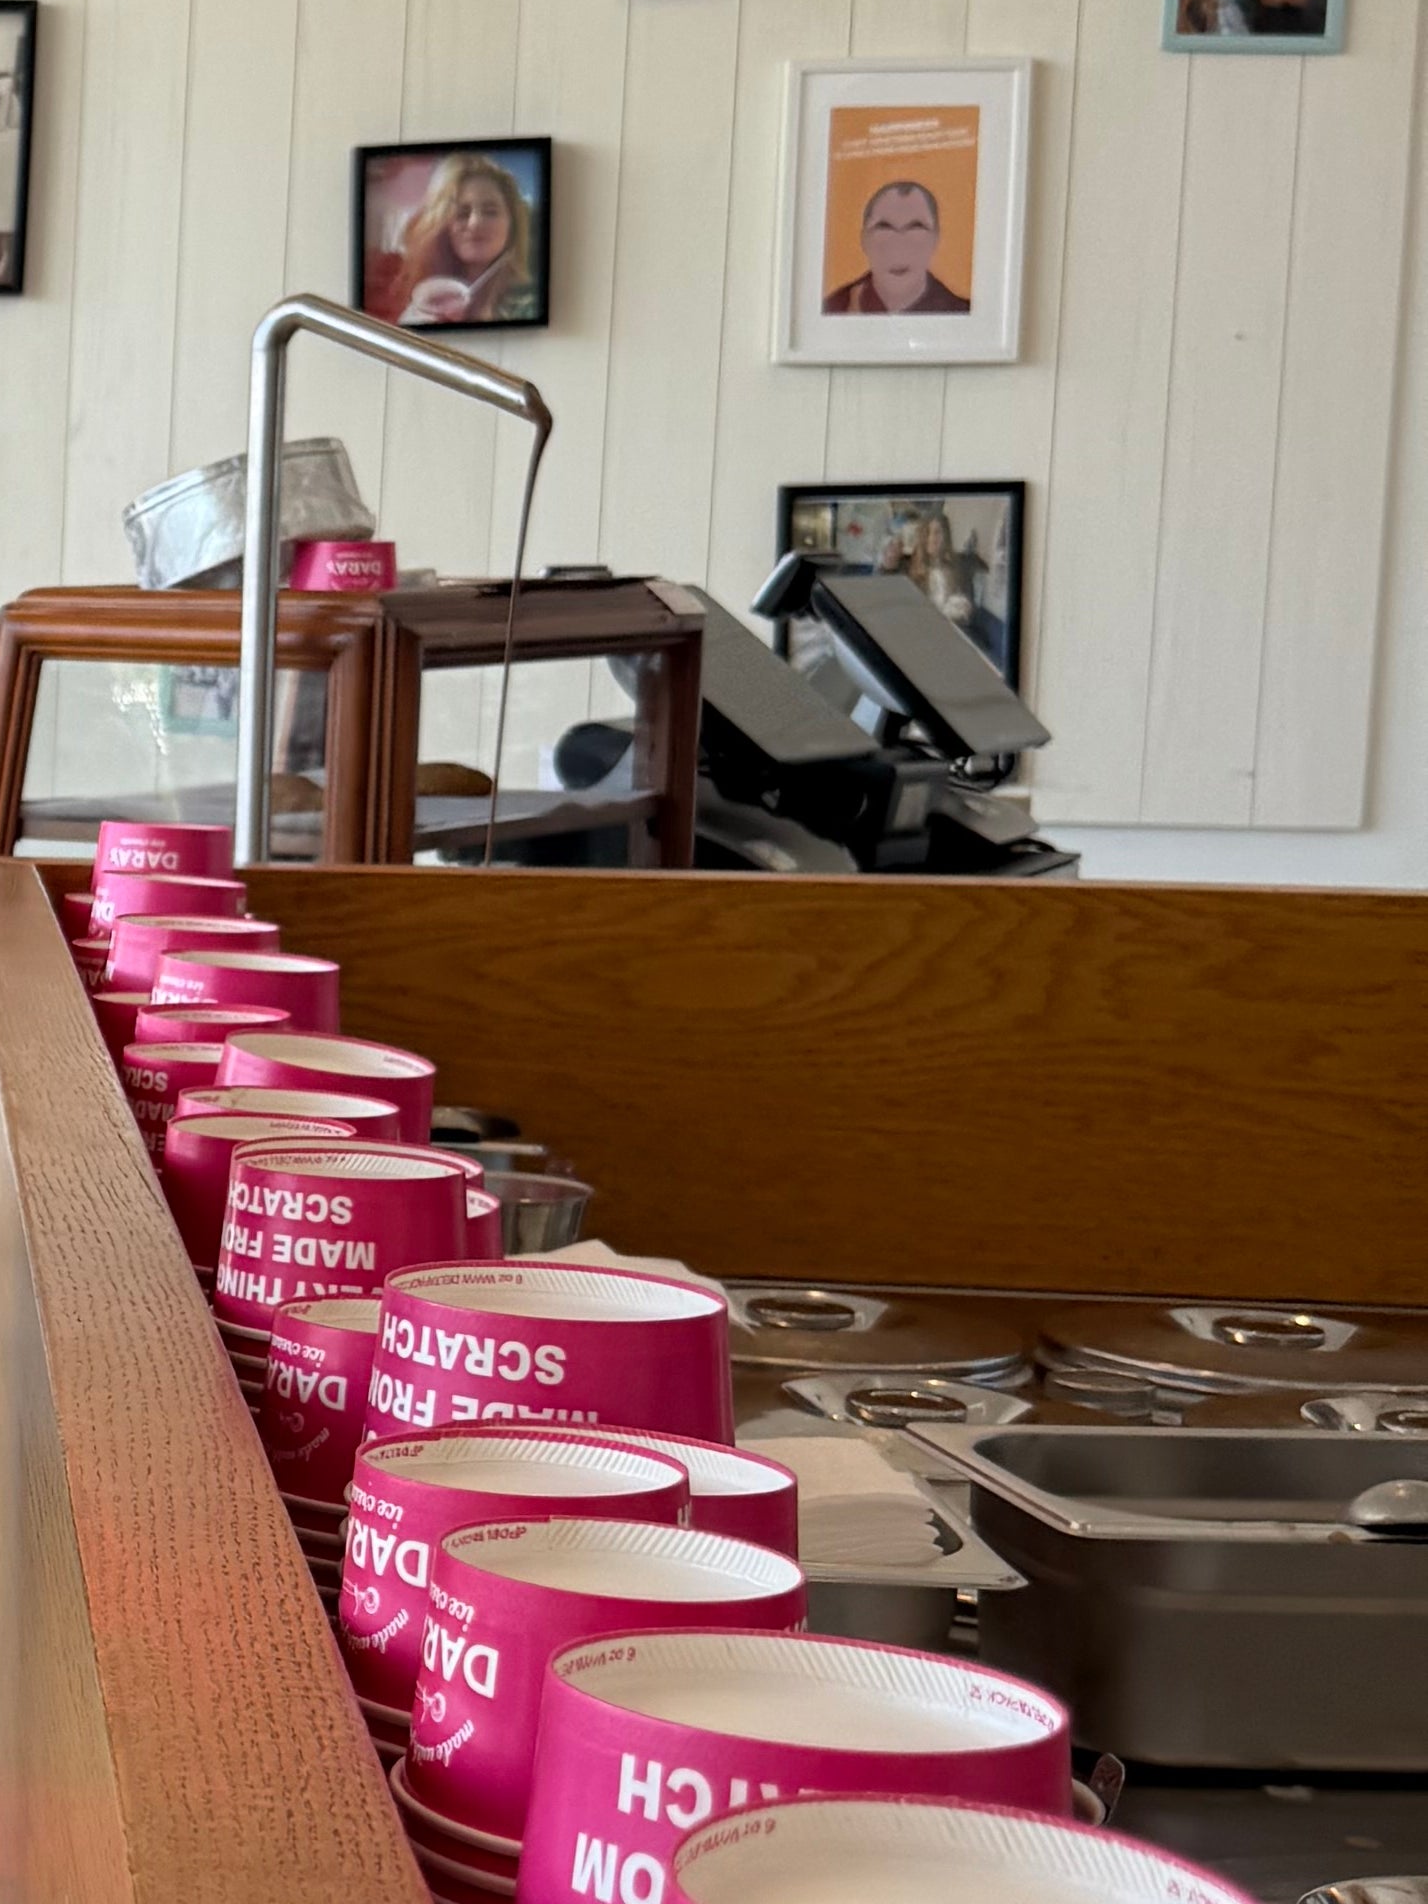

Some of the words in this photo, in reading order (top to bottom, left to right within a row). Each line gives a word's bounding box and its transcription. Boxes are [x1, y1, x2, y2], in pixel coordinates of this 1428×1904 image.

[221, 1222, 263, 1259] FRO
[272, 1234, 376, 1271] MADE
[381, 1311, 567, 1386] SCRATCH
[377, 1501, 404, 1530] ice
[371, 1608, 410, 1654] made
[448, 1596, 476, 1633] ice
[434, 1719, 475, 1768] made
